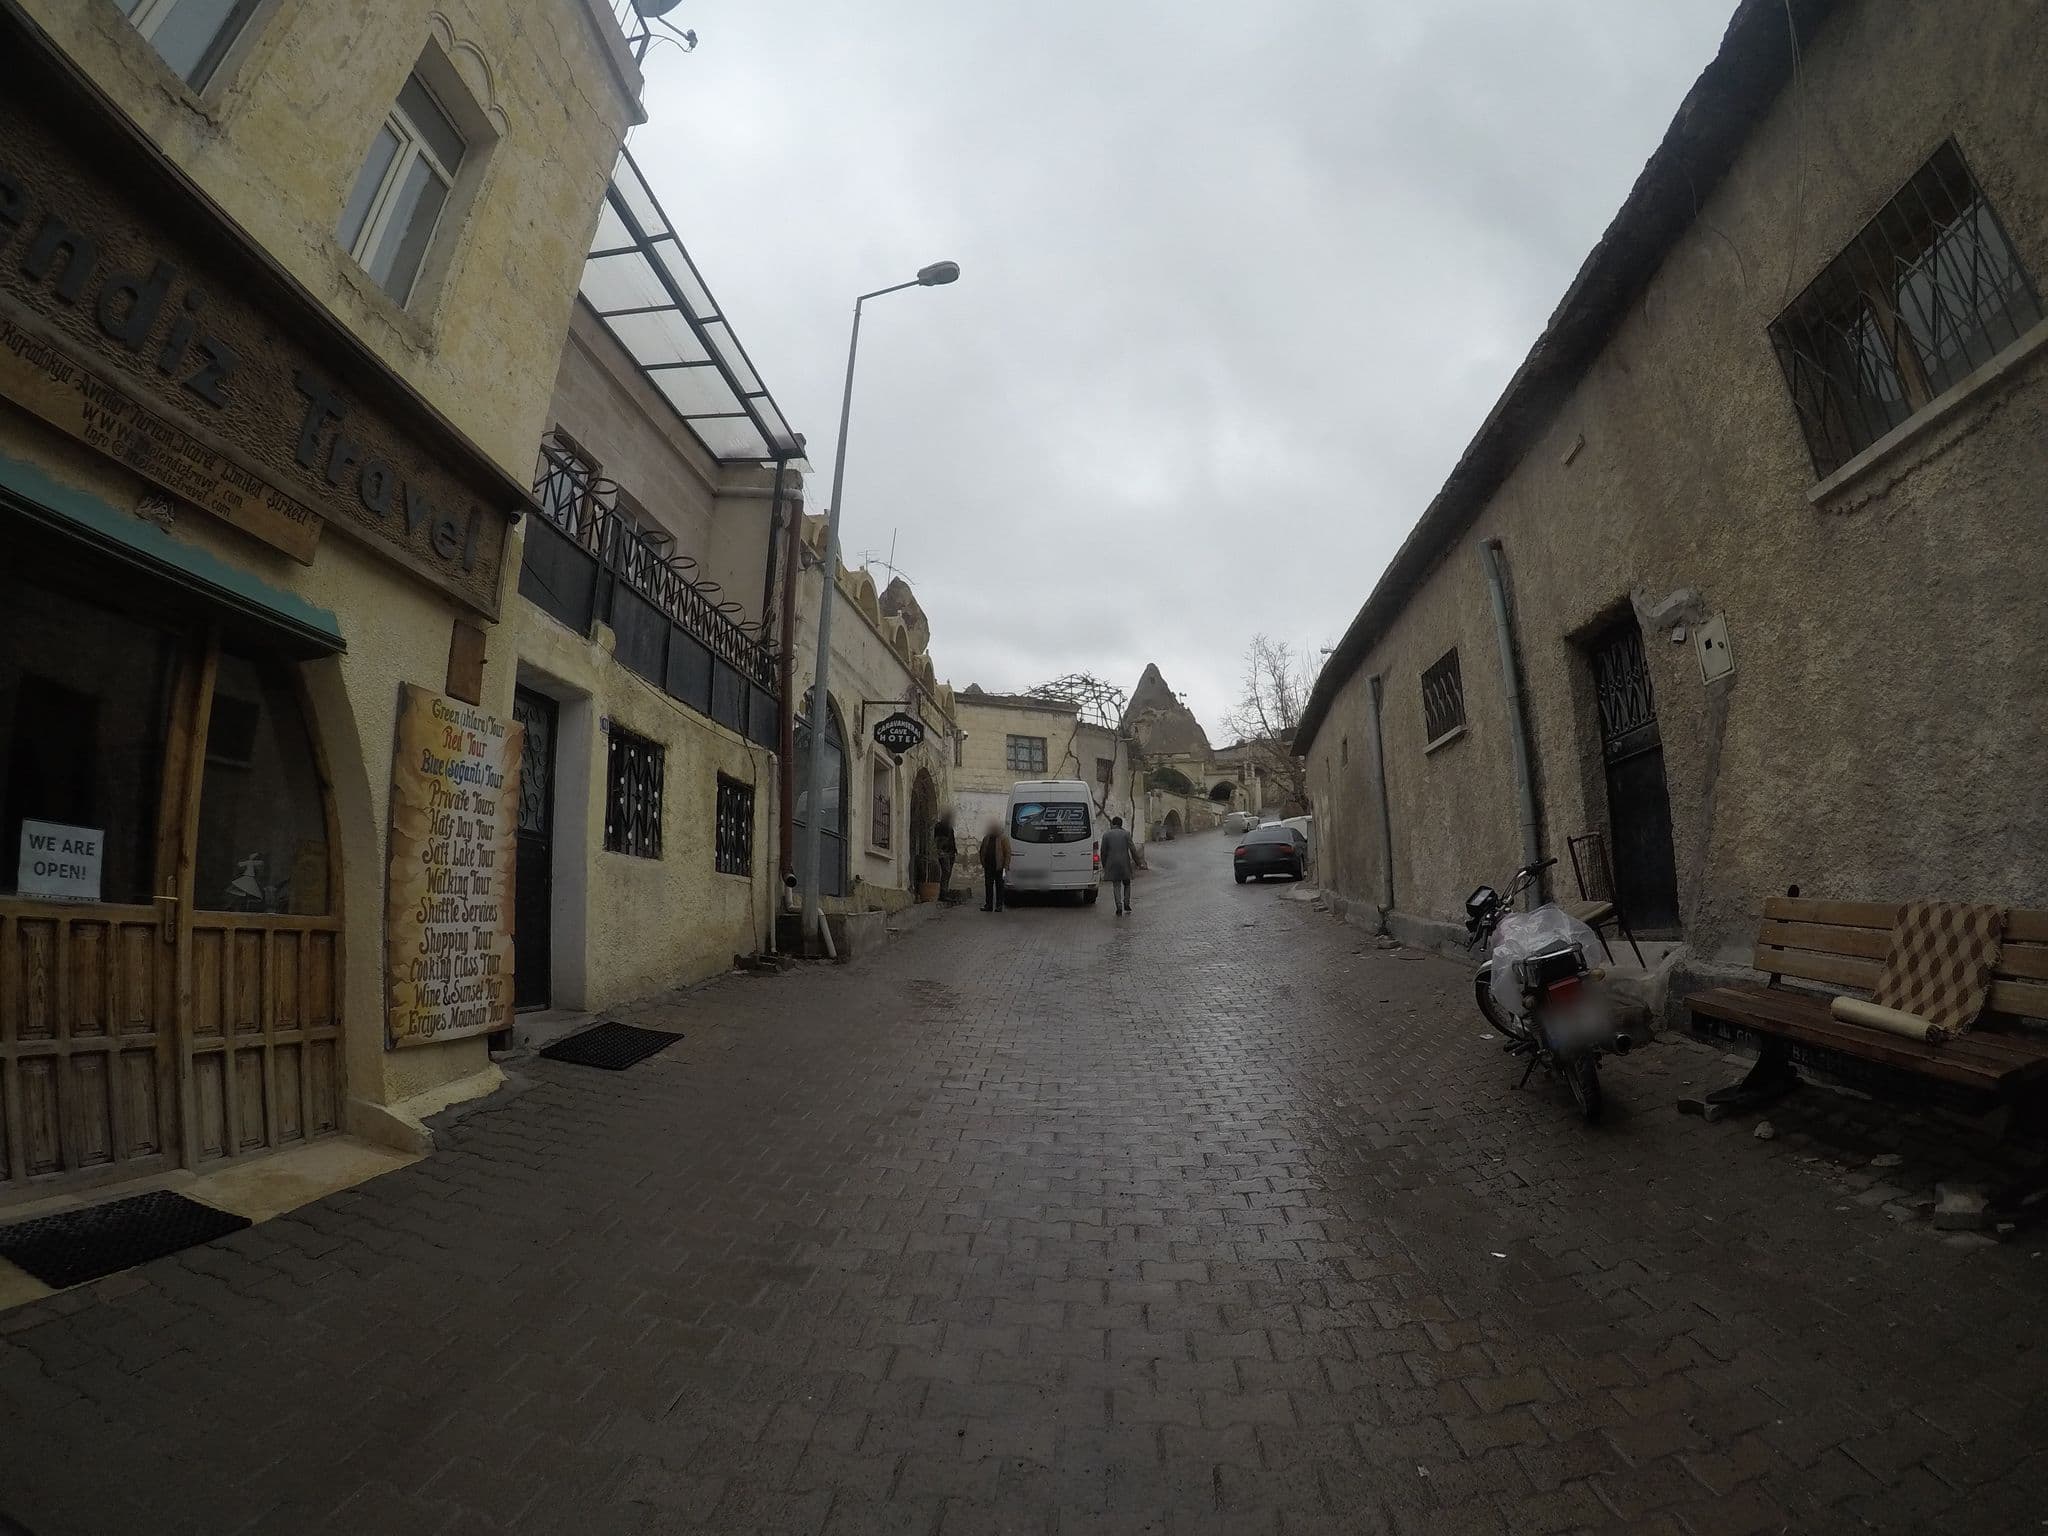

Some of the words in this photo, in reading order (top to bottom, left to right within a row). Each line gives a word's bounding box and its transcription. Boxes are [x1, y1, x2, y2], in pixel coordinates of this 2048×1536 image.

[293, 369, 482, 574] Travel
[432, 699, 460, 725] Green
[488, 716, 505, 738] Tour
[442, 726, 463, 752] Red
[467, 732, 488, 758] Tour
[879, 734, 918, 744] HOTEL
[421, 748, 444, 775] Blue
[485, 764, 504, 789] Tour
[429, 779, 470, 811] Private
[473, 791, 495, 816] Tours
[429, 808, 454, 840] Half
[456, 816, 474, 842] Day
[476, 819, 494, 840] Tour
[29, 833, 56, 851] WE
[61, 840, 95, 856] ARE
[452, 840, 475, 867] Lake
[477, 843, 495, 867] Tour
[34, 861, 86, 880] OPEN!
[425, 867, 469, 900] Walking
[471, 870, 492, 895] Tour
[416, 897, 459, 924] Shuttle
[460, 897, 498, 924] Services
[419, 927, 468, 957] Shopping
[472, 925, 493, 951] Tour
[409, 957, 451, 983] Cooking
[454, 954, 479, 978] Class
[480, 953, 501, 976] Tour
[414, 982, 441, 1009] Wine
[451, 979, 484, 1004] Sunset
[485, 977, 502, 1000] Tour
[407, 1009, 447, 1037] Erciyes
[449, 1006, 488, 1030] Mountain
[488, 1001, 505, 1022] Tour
